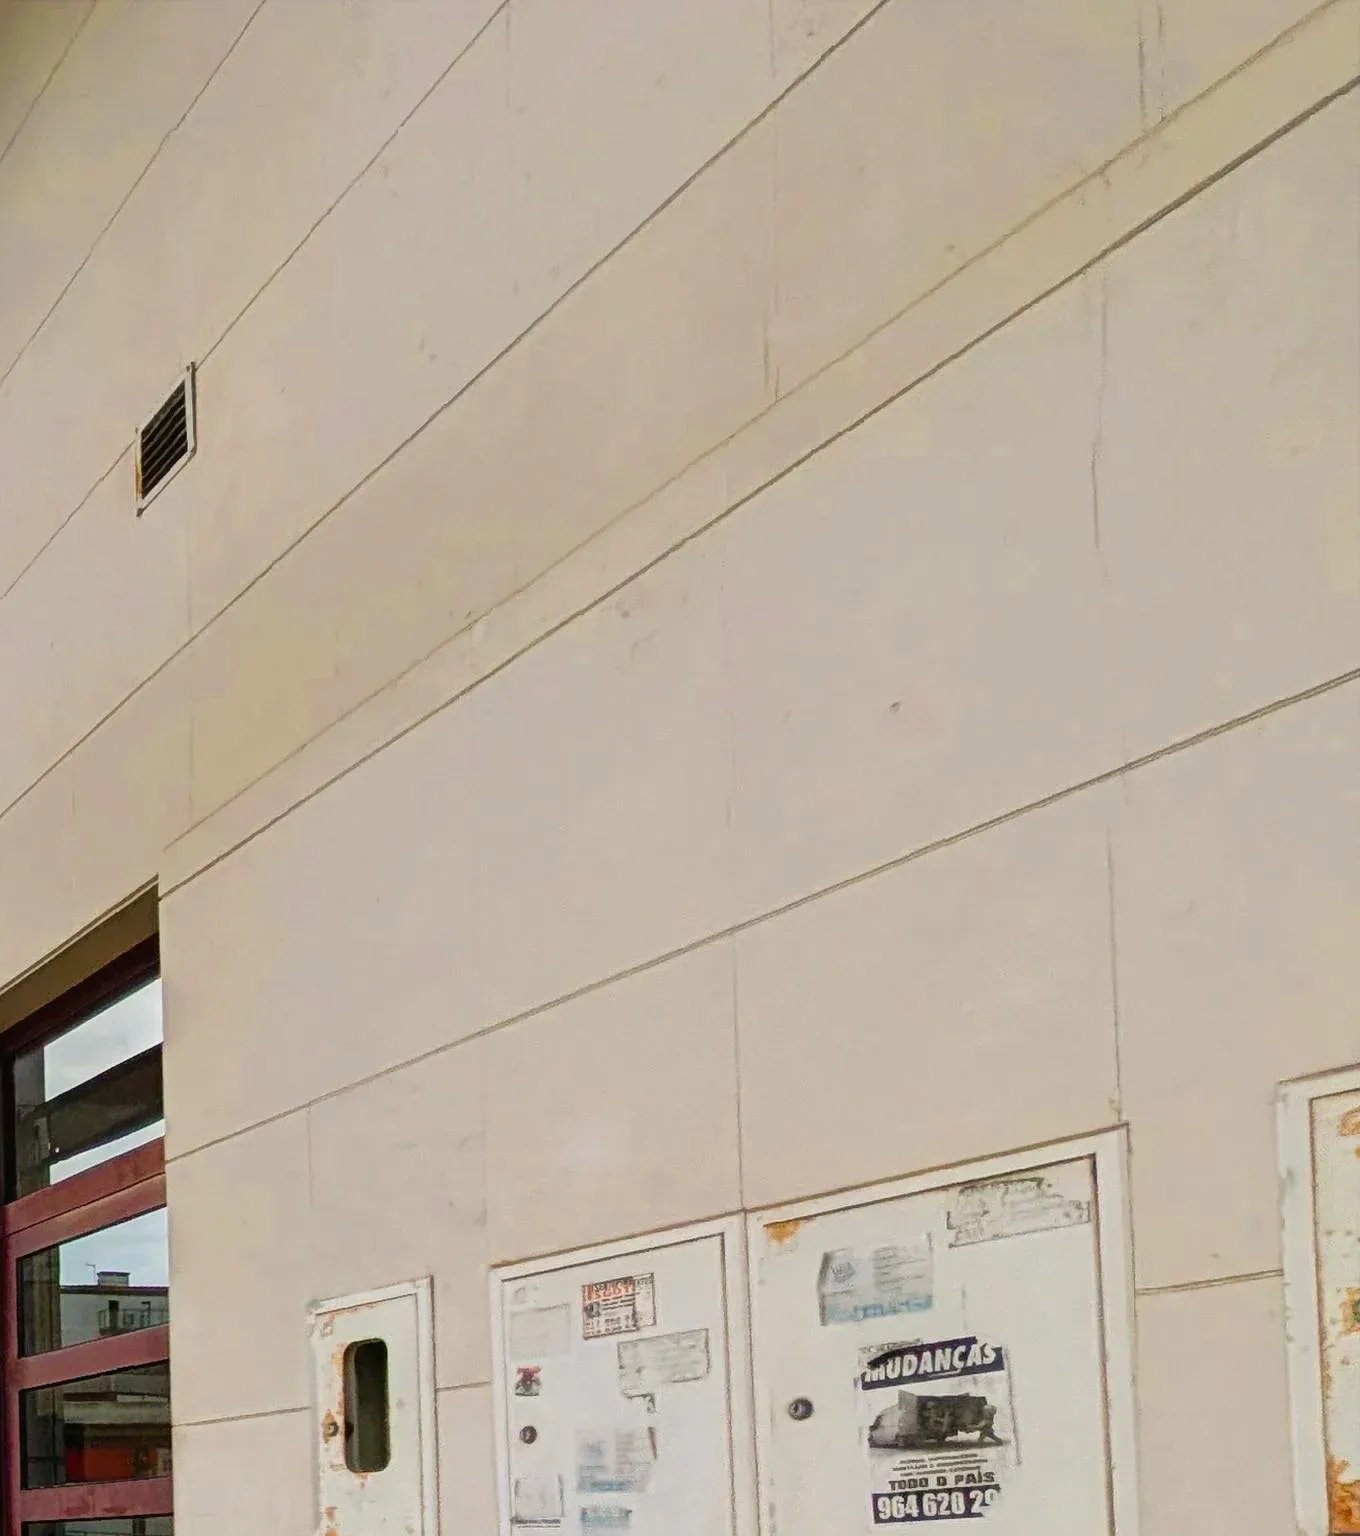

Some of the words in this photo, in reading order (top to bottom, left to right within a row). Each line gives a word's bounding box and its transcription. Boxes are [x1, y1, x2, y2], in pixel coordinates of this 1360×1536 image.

[864, 1342, 997, 1384] MUDANÇAS
[888, 1477, 929, 1491] TODO
[954, 1470, 996, 1486] PAÍS
[877, 1494, 920, 1521] 964
[922, 1490, 966, 1518] 620
